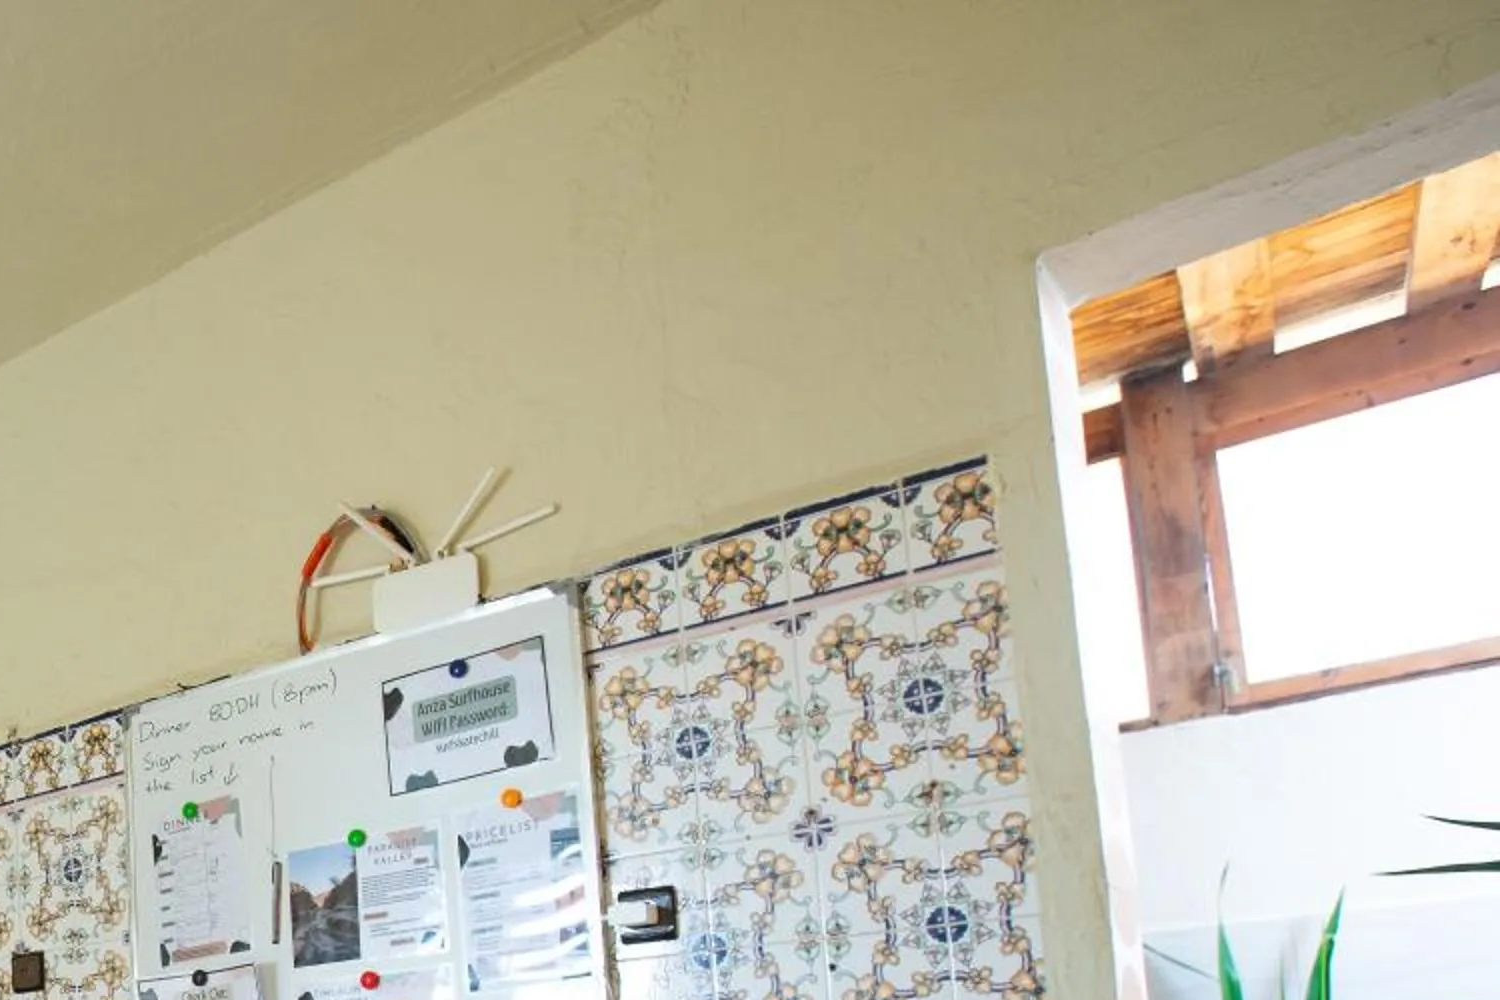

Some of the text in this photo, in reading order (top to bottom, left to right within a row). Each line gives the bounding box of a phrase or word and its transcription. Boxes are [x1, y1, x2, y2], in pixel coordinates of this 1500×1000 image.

[417, 680, 511, 718] Anza Surfhouse
[138, 720, 191, 743] Dinner
[142, 719, 315, 773] Sign your name in
[145, 765, 214, 793] the list
